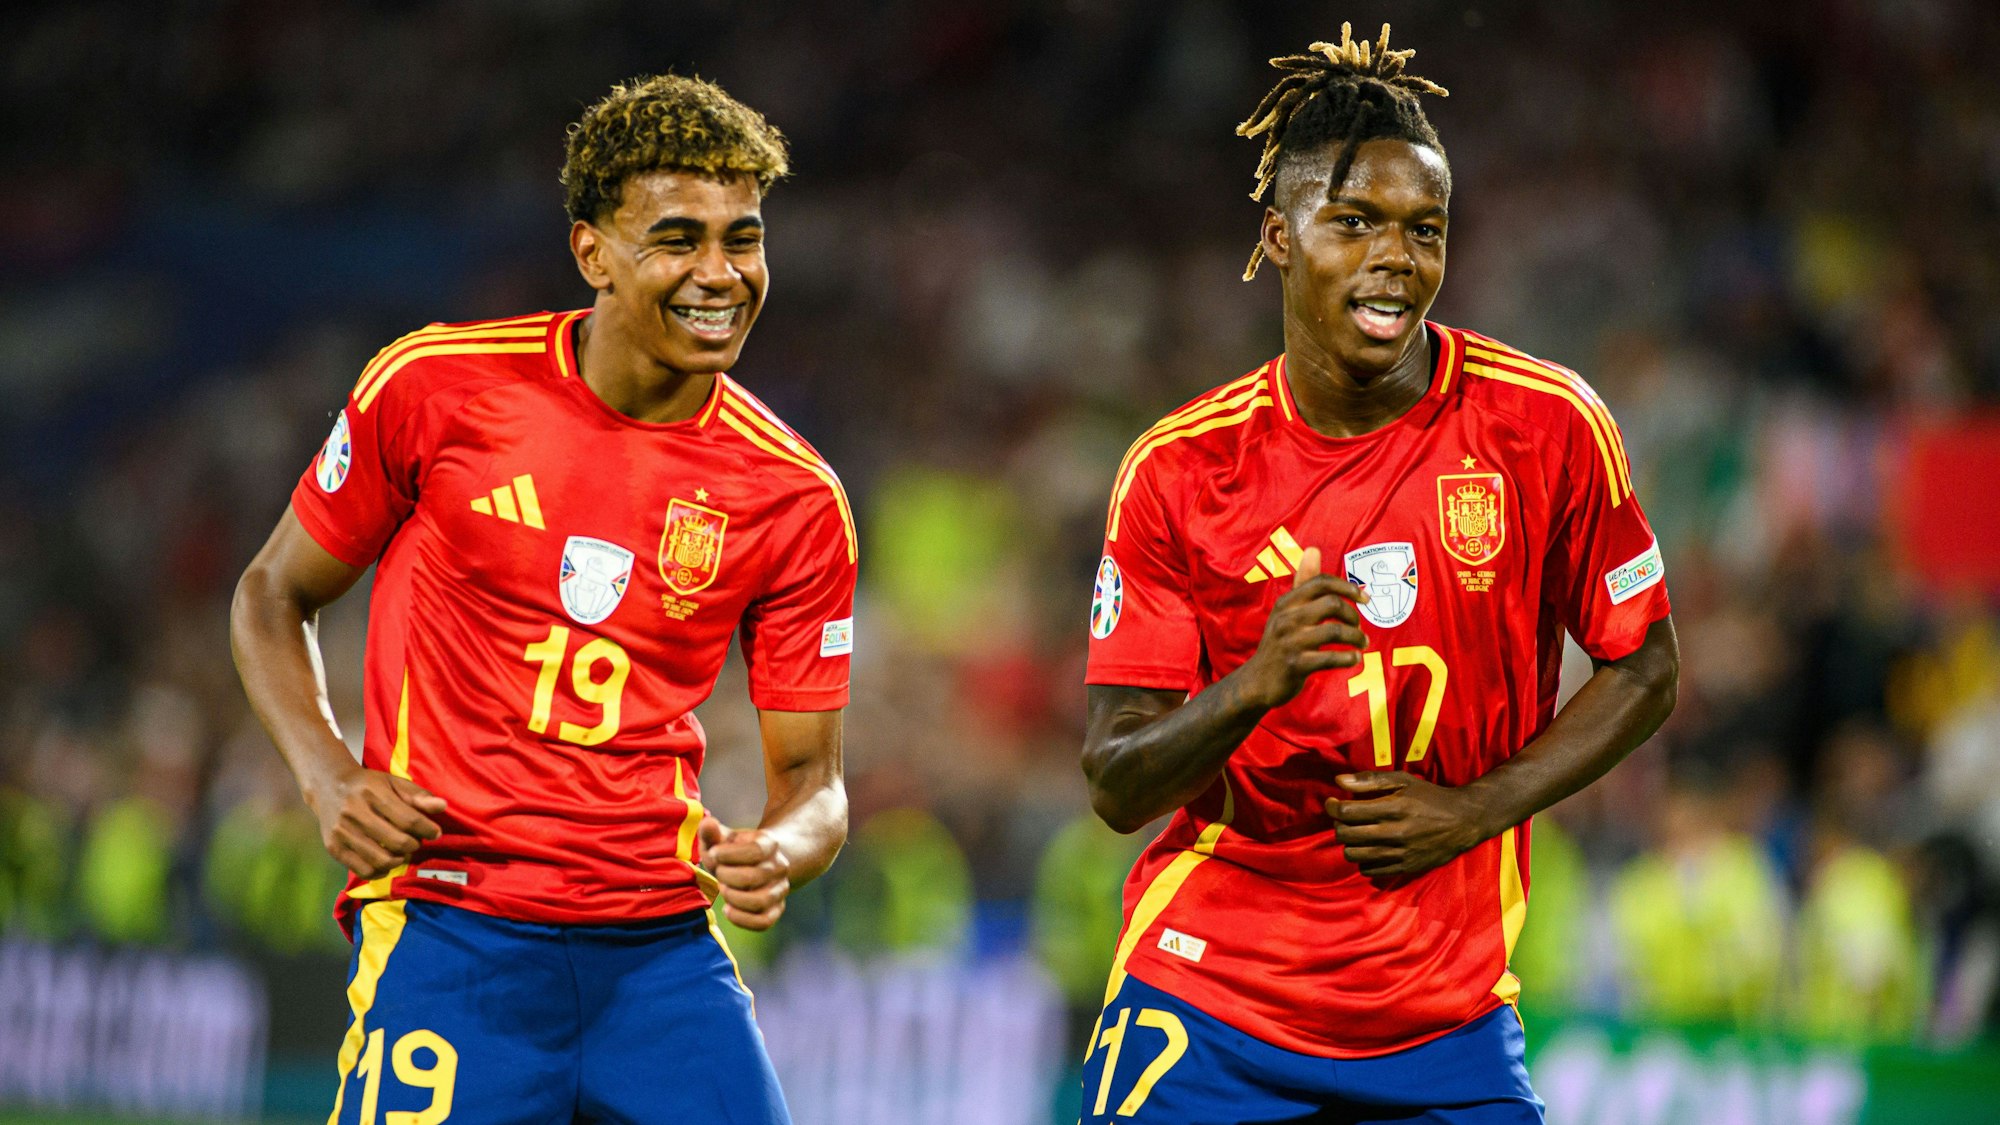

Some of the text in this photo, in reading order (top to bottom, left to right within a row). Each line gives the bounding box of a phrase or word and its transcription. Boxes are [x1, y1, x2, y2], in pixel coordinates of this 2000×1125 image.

[1362, 546, 1387, 555] NATIONS
[1608, 568, 1627, 582] UEFA
[1373, 616, 1395, 624] WINNER
[524, 624, 631, 746] 19
[1347, 645, 1448, 767] 17
[357, 1028, 459, 1125] 19
[1093, 1007, 1189, 1117] 17
